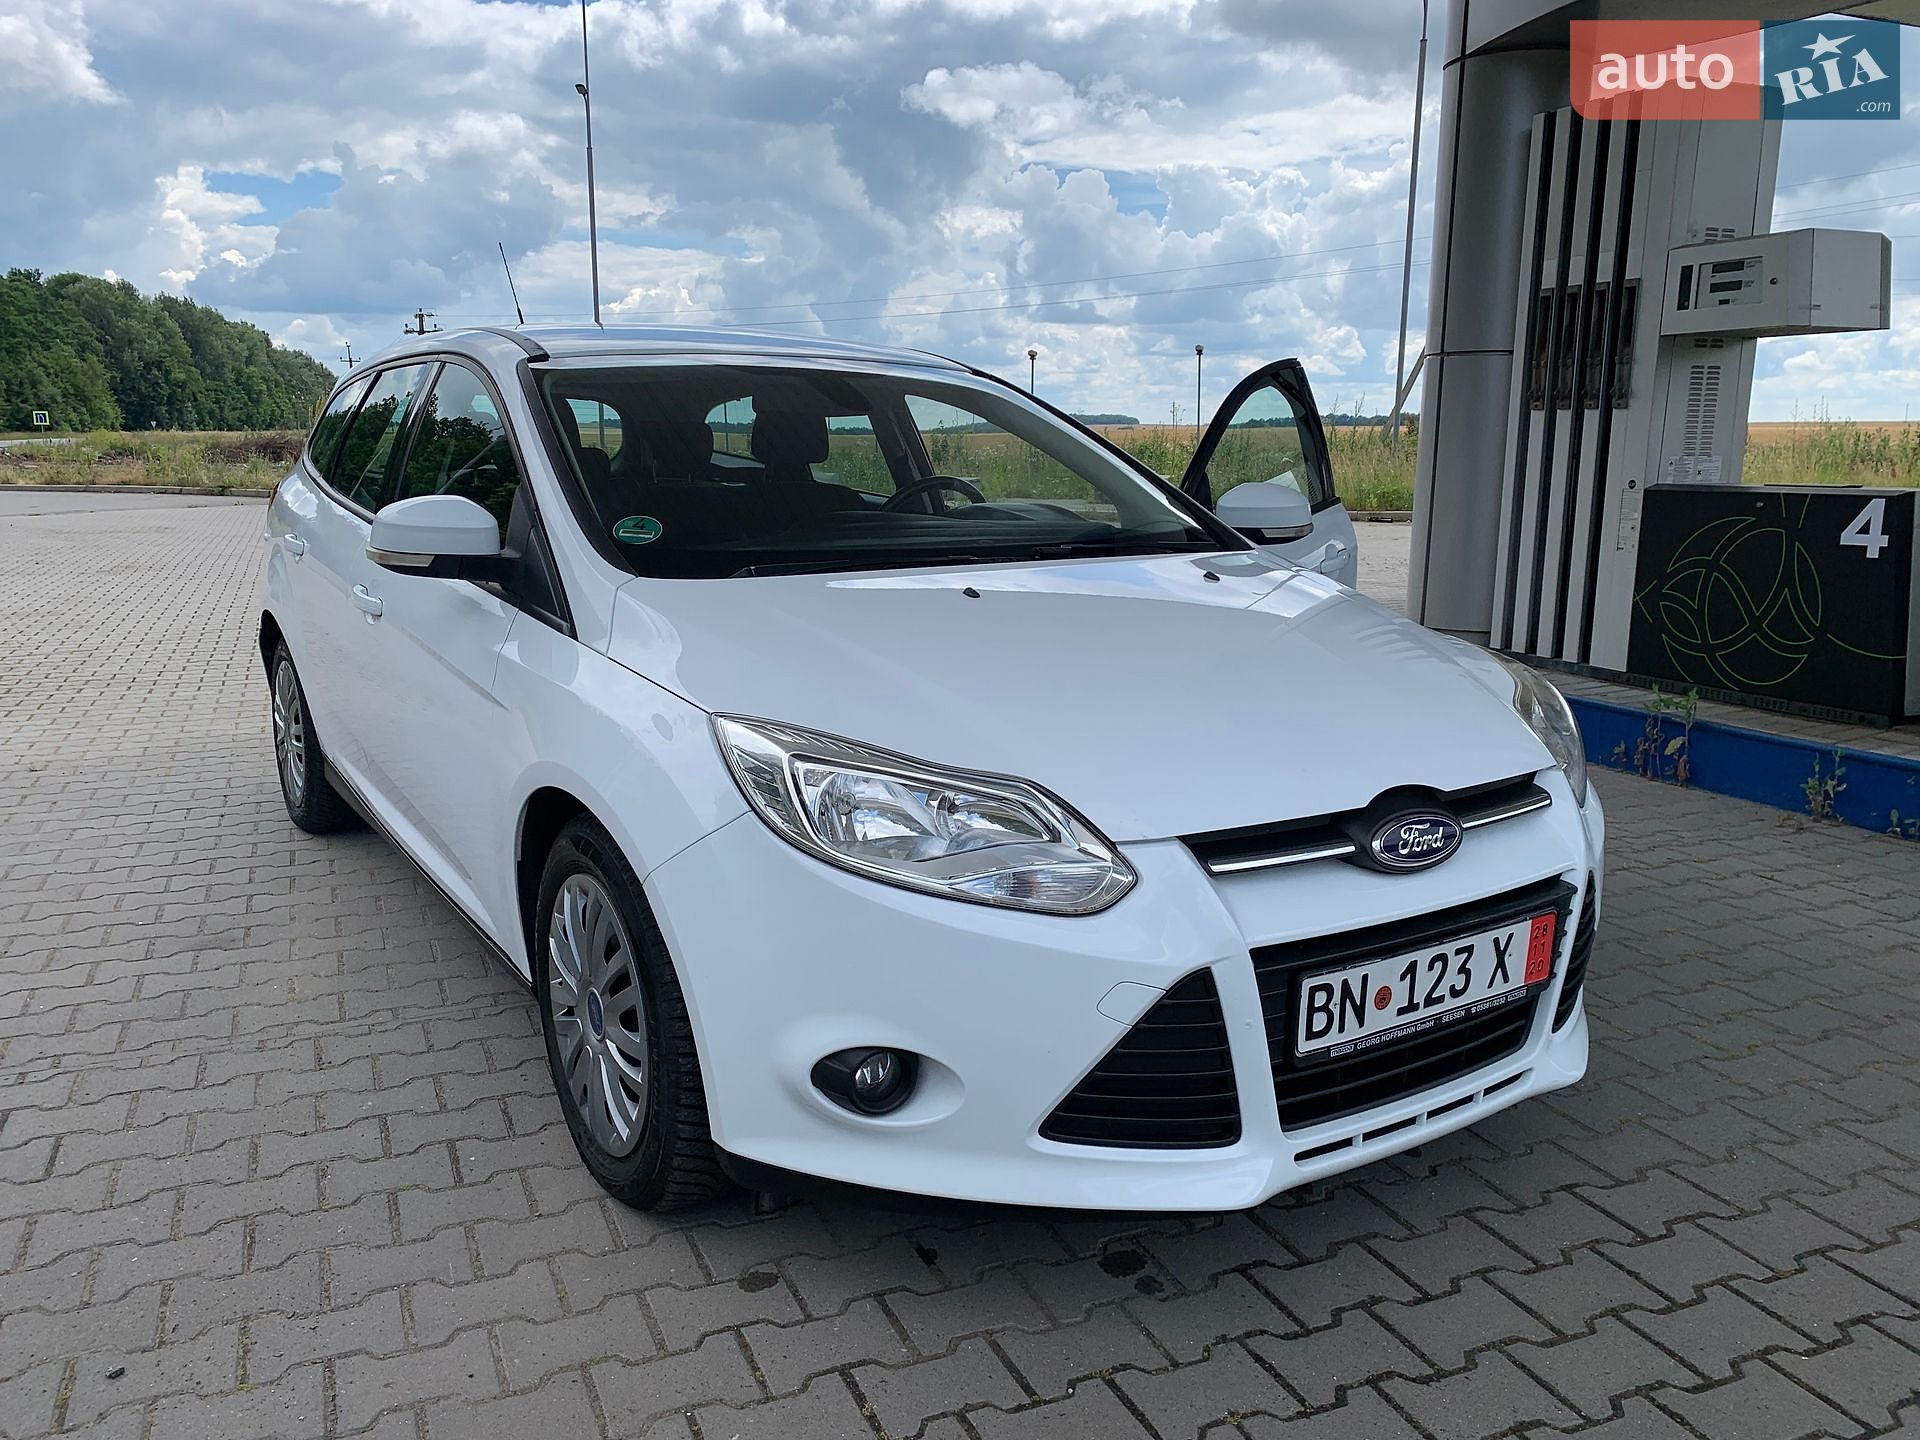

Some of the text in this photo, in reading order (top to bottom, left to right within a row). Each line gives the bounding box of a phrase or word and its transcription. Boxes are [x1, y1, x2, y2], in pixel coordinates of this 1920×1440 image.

[1840, 498, 1889, 558] 4
[1399, 822, 1444, 854] Ford
[1533, 923, 1548, 940] 28
[1533, 941, 1546, 957] 11
[1528, 959, 1544, 976] 20
[1304, 932, 1514, 1041] BN 123 X
[1357, 1036, 1380, 1049] GEORG
[1381, 1026, 1416, 1042] HOFFMANN
[1416, 1019, 1434, 1031] GmbH
[1442, 1010, 1465, 1023] SEESEN
